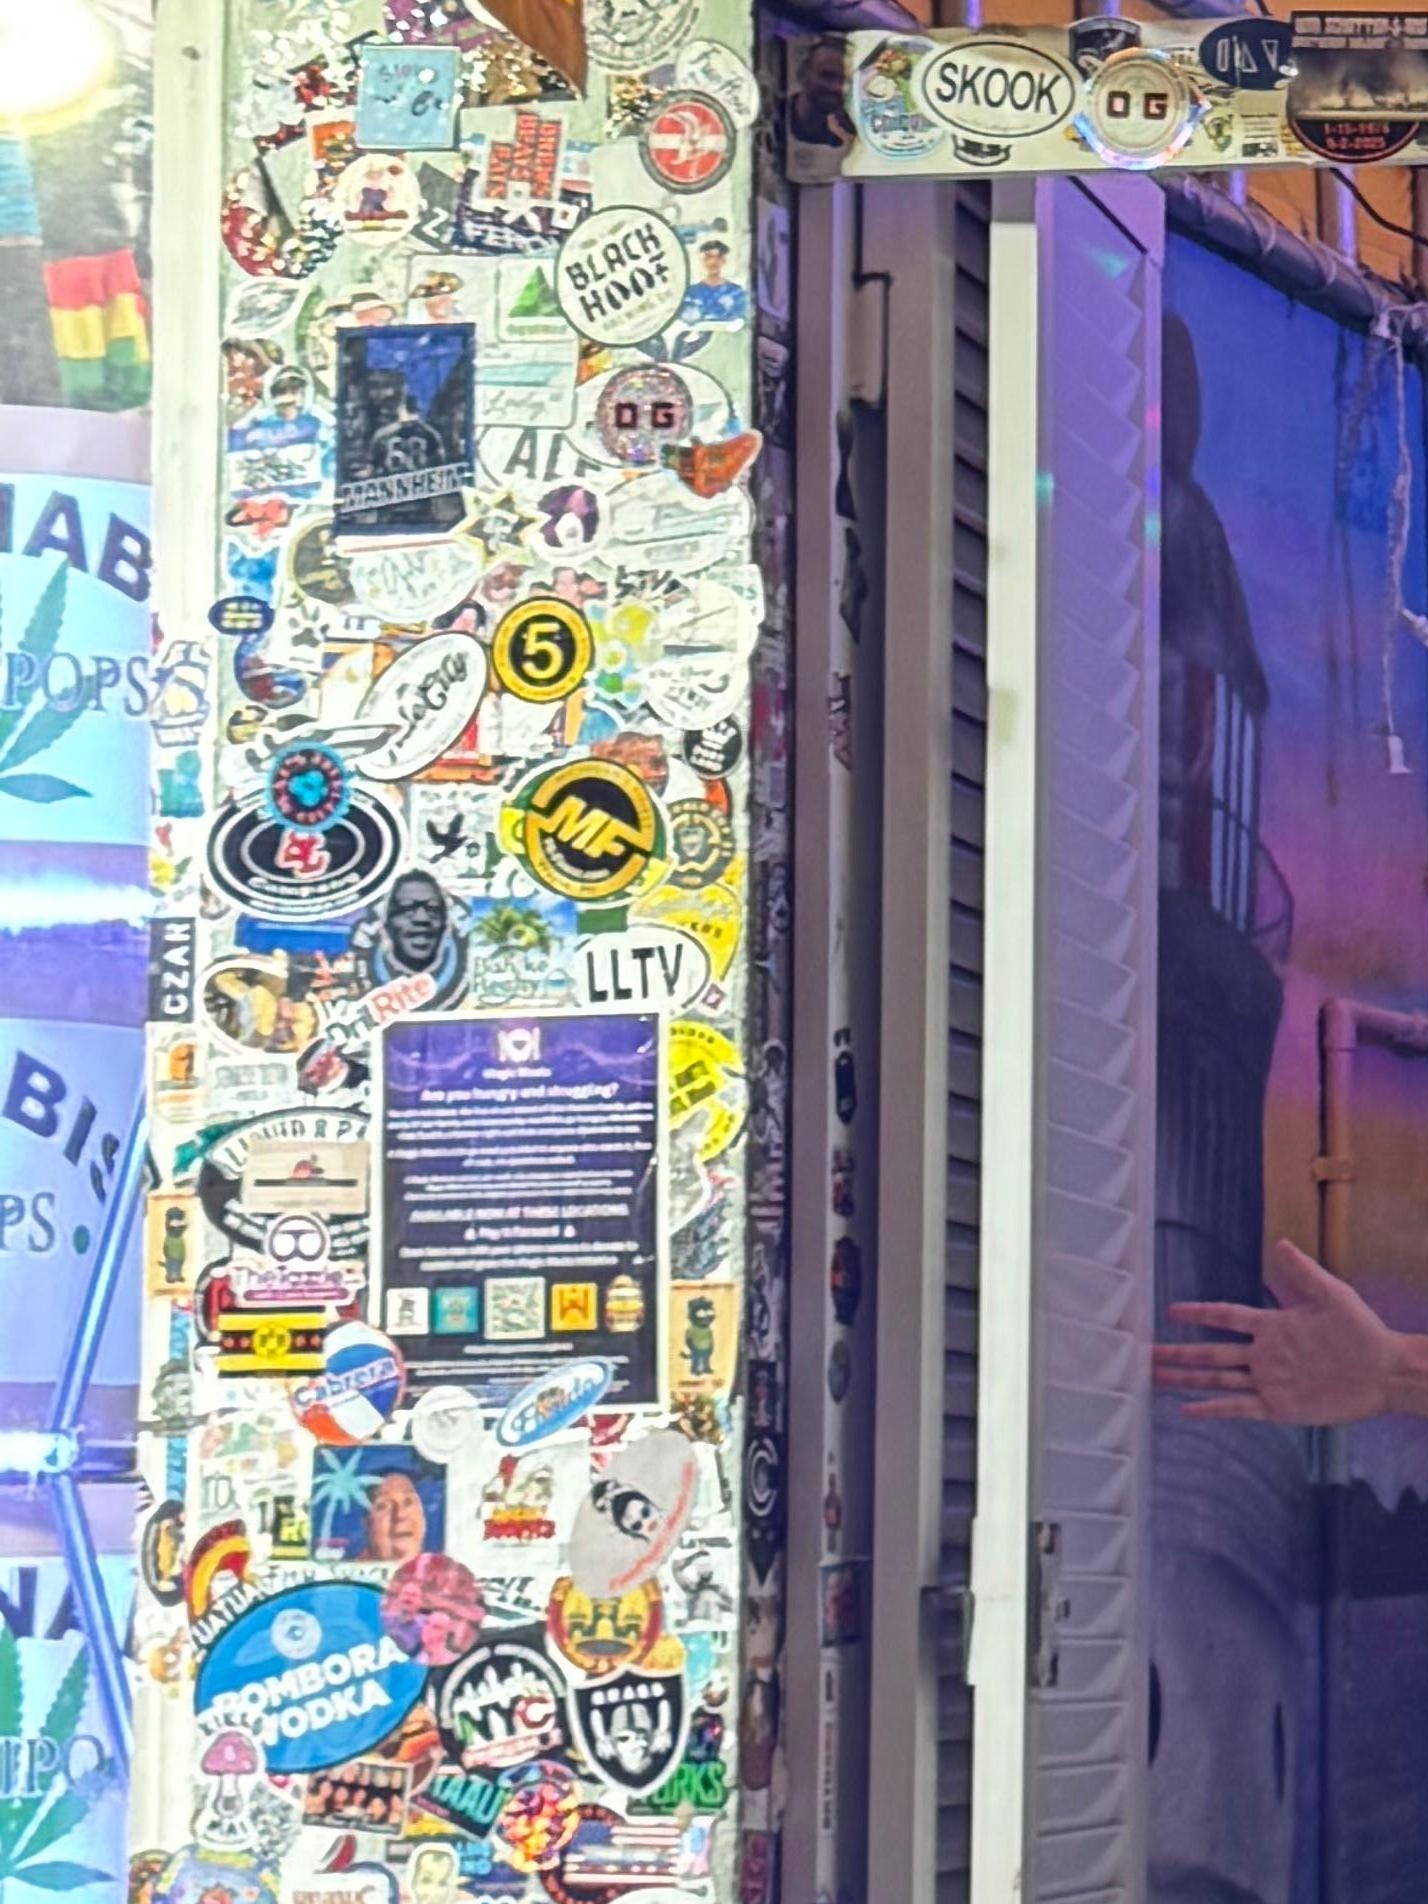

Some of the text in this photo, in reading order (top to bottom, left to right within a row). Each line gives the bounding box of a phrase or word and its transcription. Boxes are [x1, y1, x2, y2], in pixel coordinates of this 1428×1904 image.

[937, 62, 1062, 117] SKOOK
[565, 222, 662, 292] BLACK
[521, 622, 564, 674] 5
[587, 943, 684, 1001] LLTV
[211, 1636, 411, 1718] BOMBORA
[257, 1680, 392, 1747] VODKA
